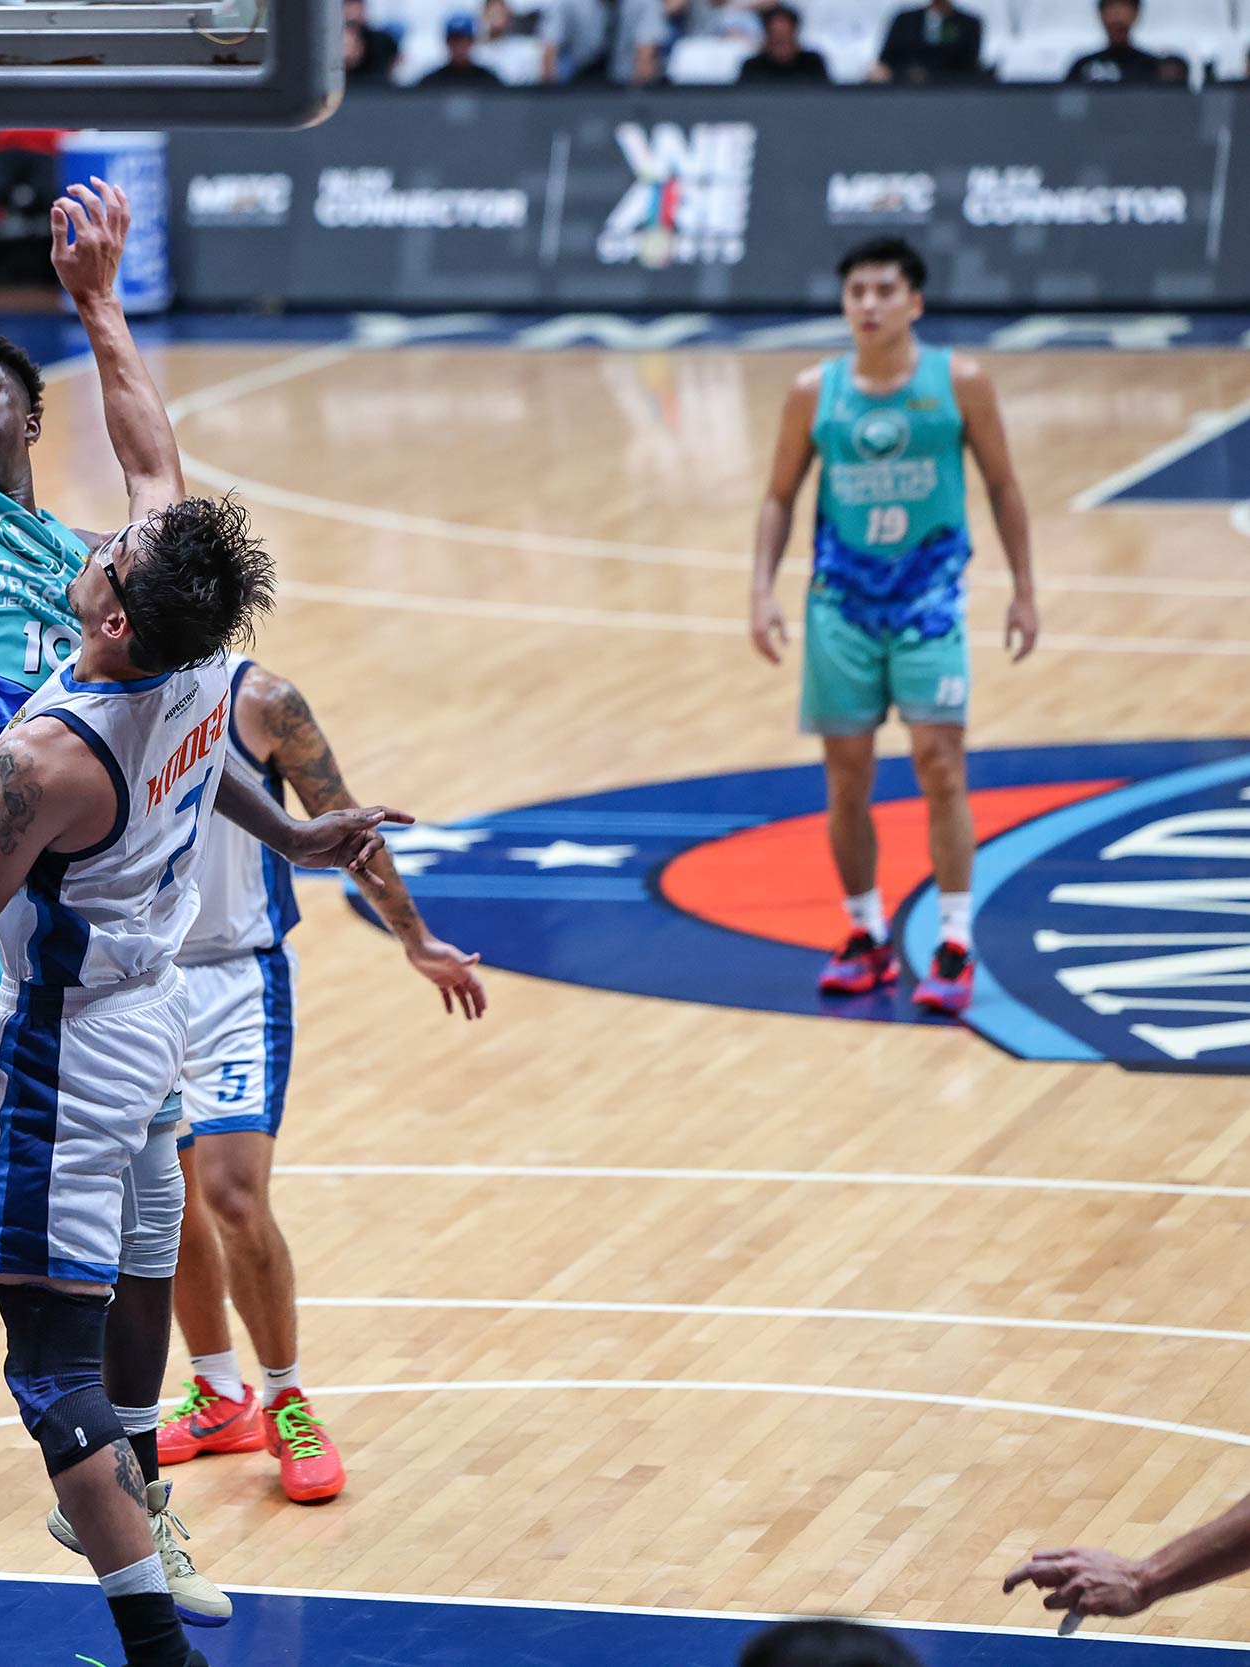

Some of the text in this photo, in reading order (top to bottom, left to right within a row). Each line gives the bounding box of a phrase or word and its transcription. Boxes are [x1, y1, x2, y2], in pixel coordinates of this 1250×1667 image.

[616, 122, 756, 178] WE
[316, 189, 528, 228] CONNECTOR
[604, 176, 750, 234] ARE
[963, 187, 1186, 225] CONNECTOR
[866, 505, 908, 545] 19
[23, 620, 83, 674] 10
[157, 766, 214, 896] 7
[218, 1060, 253, 1102] 5
